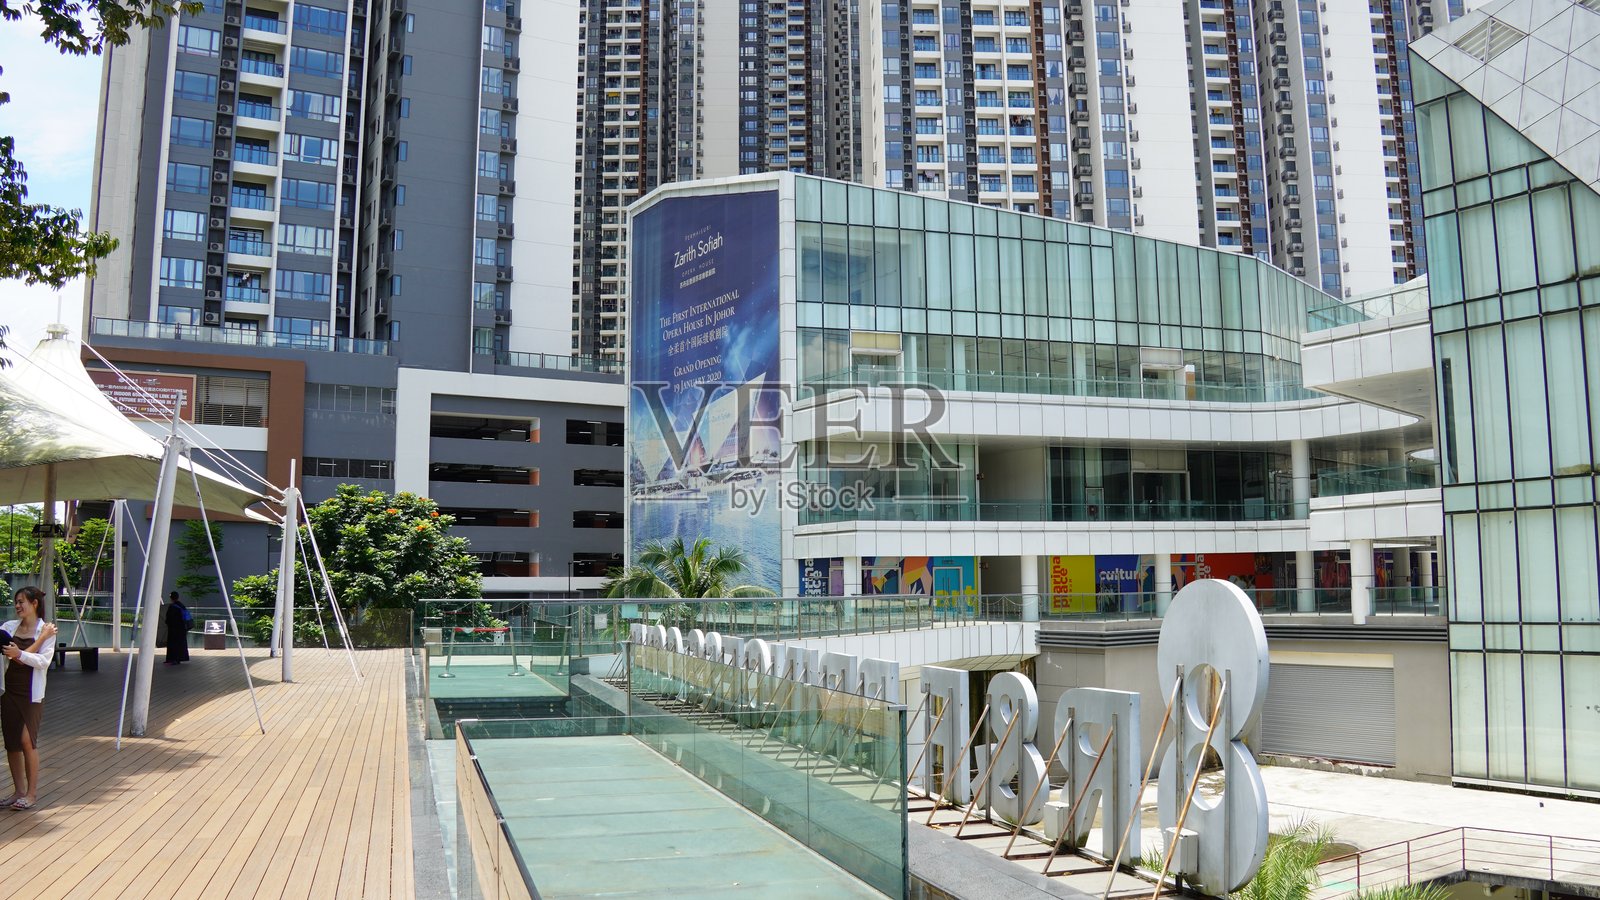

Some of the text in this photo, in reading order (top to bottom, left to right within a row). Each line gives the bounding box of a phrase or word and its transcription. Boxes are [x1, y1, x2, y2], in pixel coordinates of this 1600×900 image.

[674, 232, 723, 268] Zarith Sofiah
[681, 258, 714, 277] OPERA HOUSE
[659, 289, 740, 329] THE FIRST INTERNATIONAL
[662, 306, 735, 341] OPERA HOUSE IN JOHOR
[673, 354, 722, 377] GRAND OPENING
[673, 371, 722, 394] 19 JANUARY 2020
[1051, 556, 1061, 608] marina
[1059, 568, 1070, 608] place
